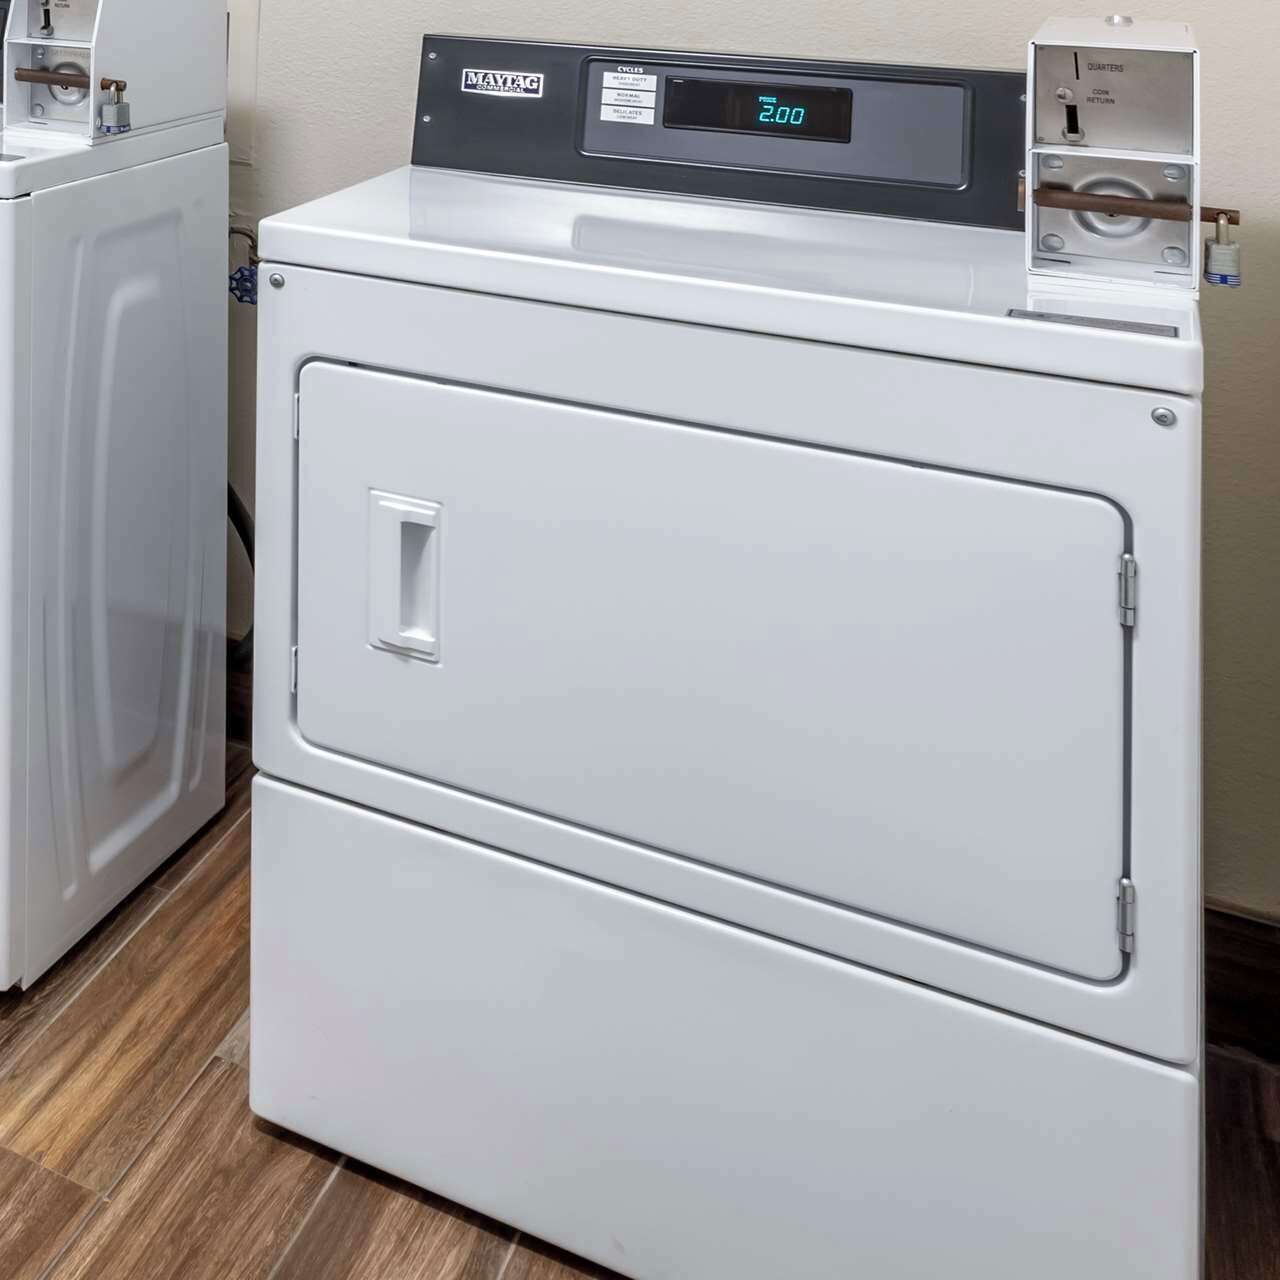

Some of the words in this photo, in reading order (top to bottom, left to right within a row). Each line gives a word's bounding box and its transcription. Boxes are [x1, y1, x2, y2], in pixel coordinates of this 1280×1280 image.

[617, 66, 643, 74] CYCLES
[1087, 62, 1124, 73] QUARTERS
[466, 72, 539, 89] MAYTAG
[1086, 96, 1115, 105] RETURN
[759, 105, 805, 125] 2.00
